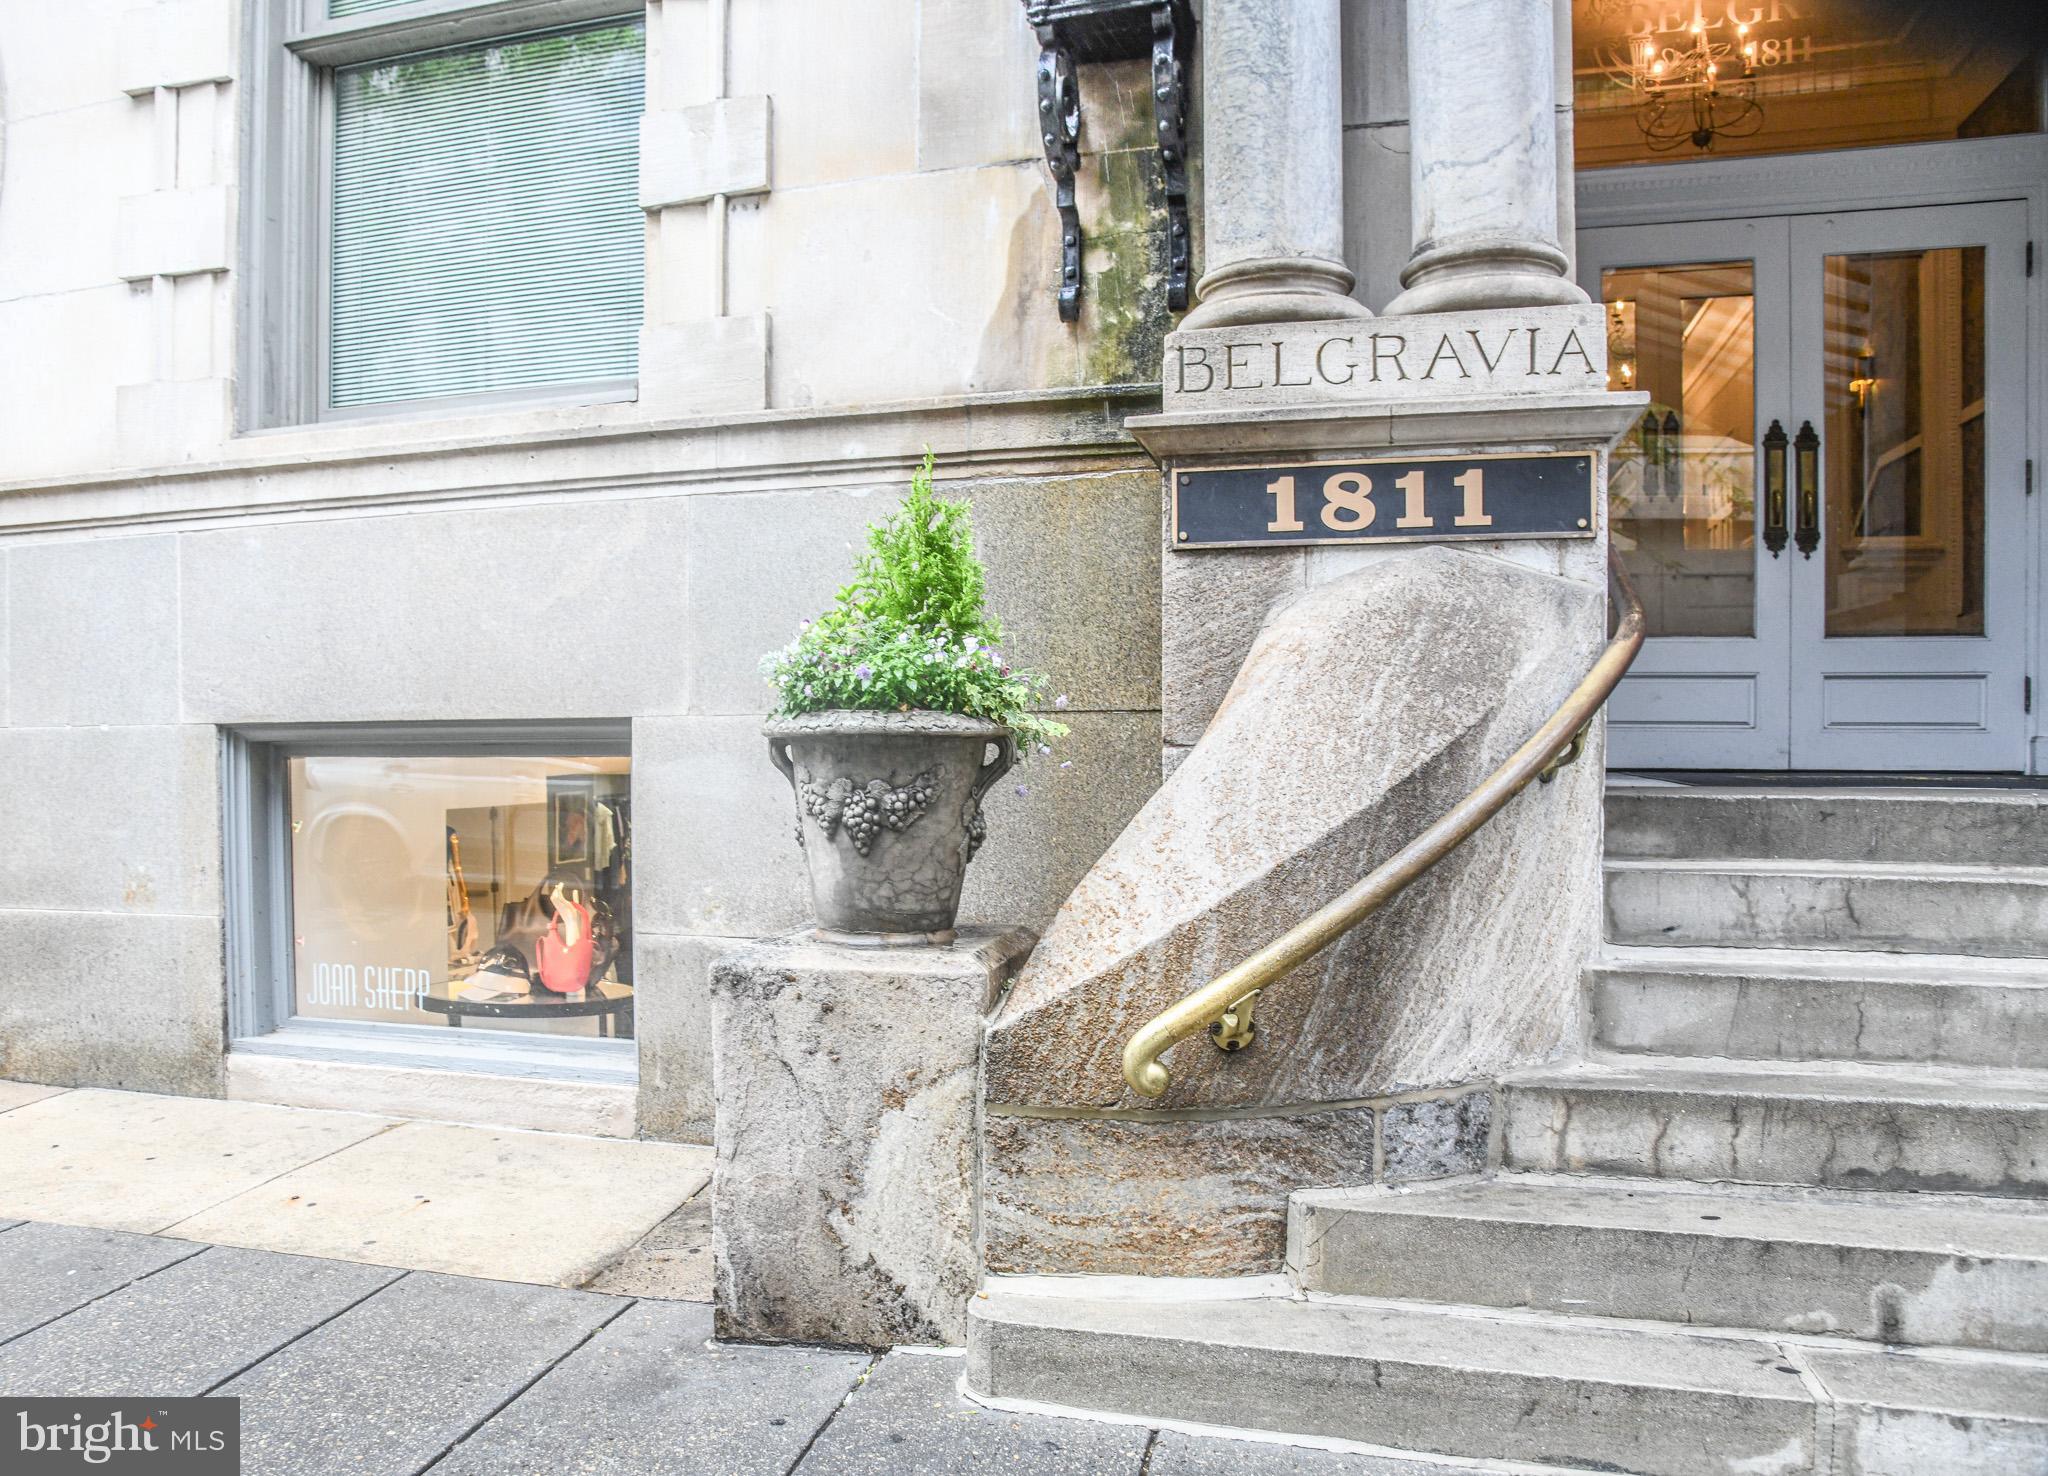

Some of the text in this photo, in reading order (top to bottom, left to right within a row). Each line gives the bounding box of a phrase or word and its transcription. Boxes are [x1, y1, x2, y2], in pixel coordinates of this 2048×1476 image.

[1748, 36, 1812, 68] 1811
[1175, 328, 1596, 394] BELGRAVIA
[1266, 468, 1492, 533] 1811
[307, 963, 431, 1011] JOAN SHEPP
